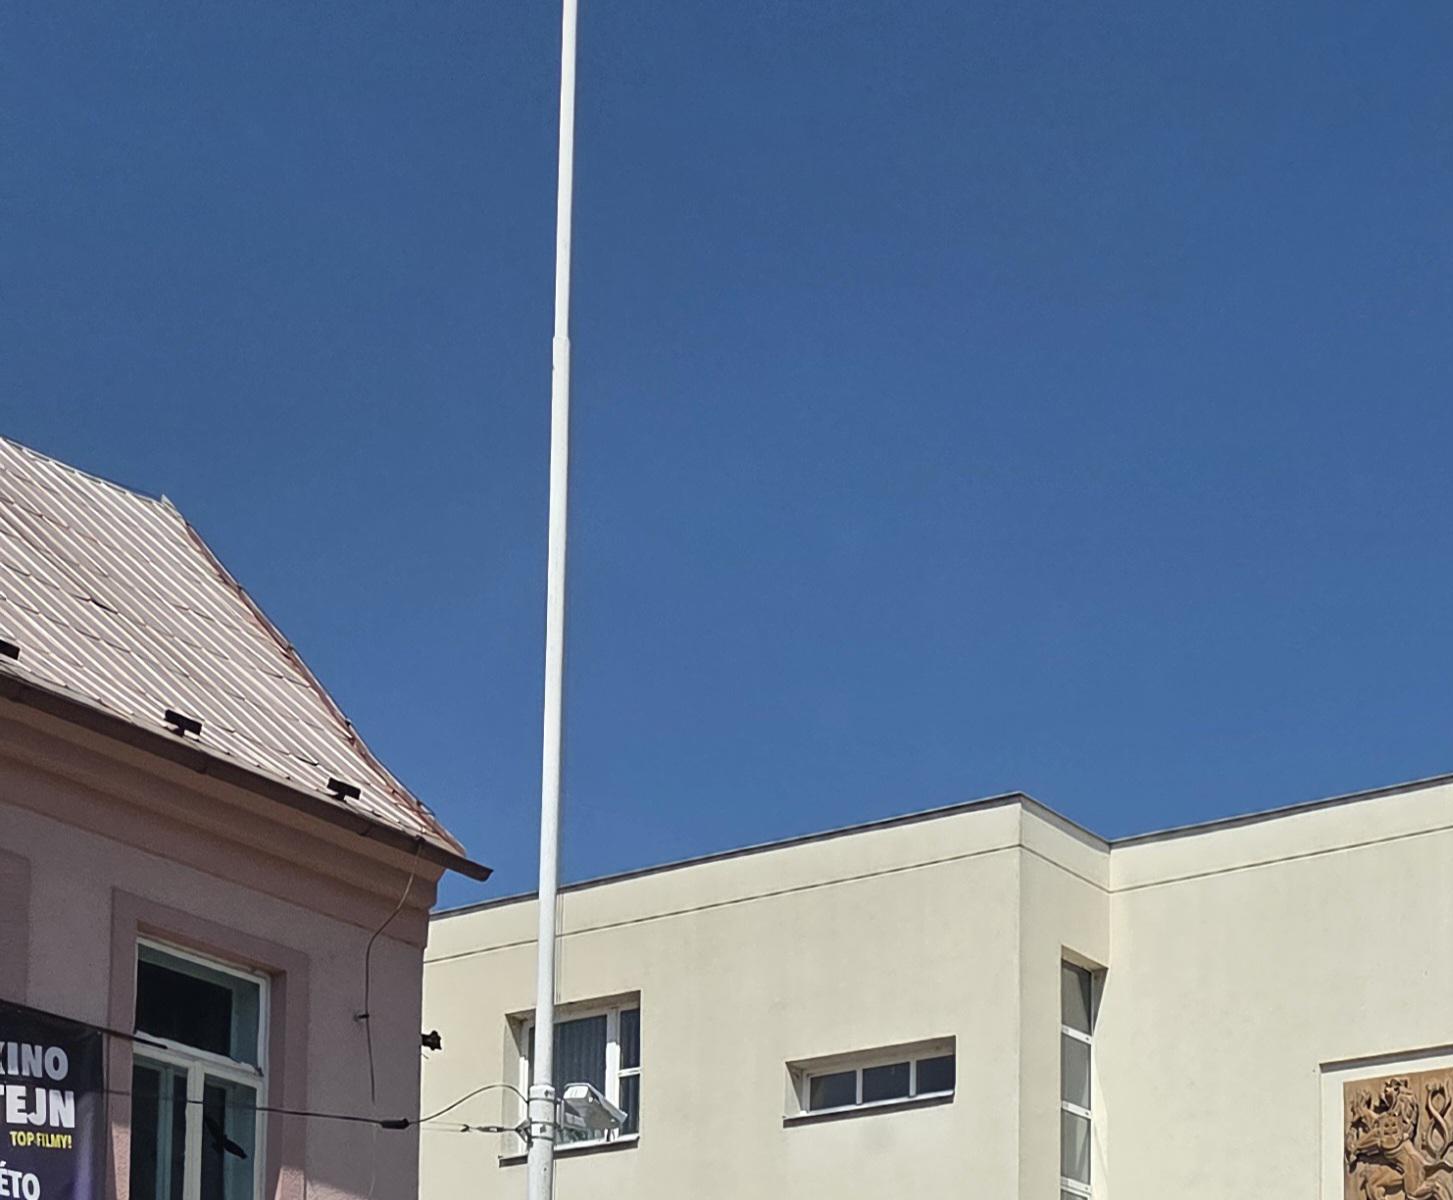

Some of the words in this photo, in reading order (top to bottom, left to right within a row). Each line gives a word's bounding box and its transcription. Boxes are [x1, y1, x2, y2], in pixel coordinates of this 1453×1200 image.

[0, 1084, 76, 1128] EJN
[9, 1131, 34, 1146] TOP
[36, 1132, 72, 1149] FILMY!
